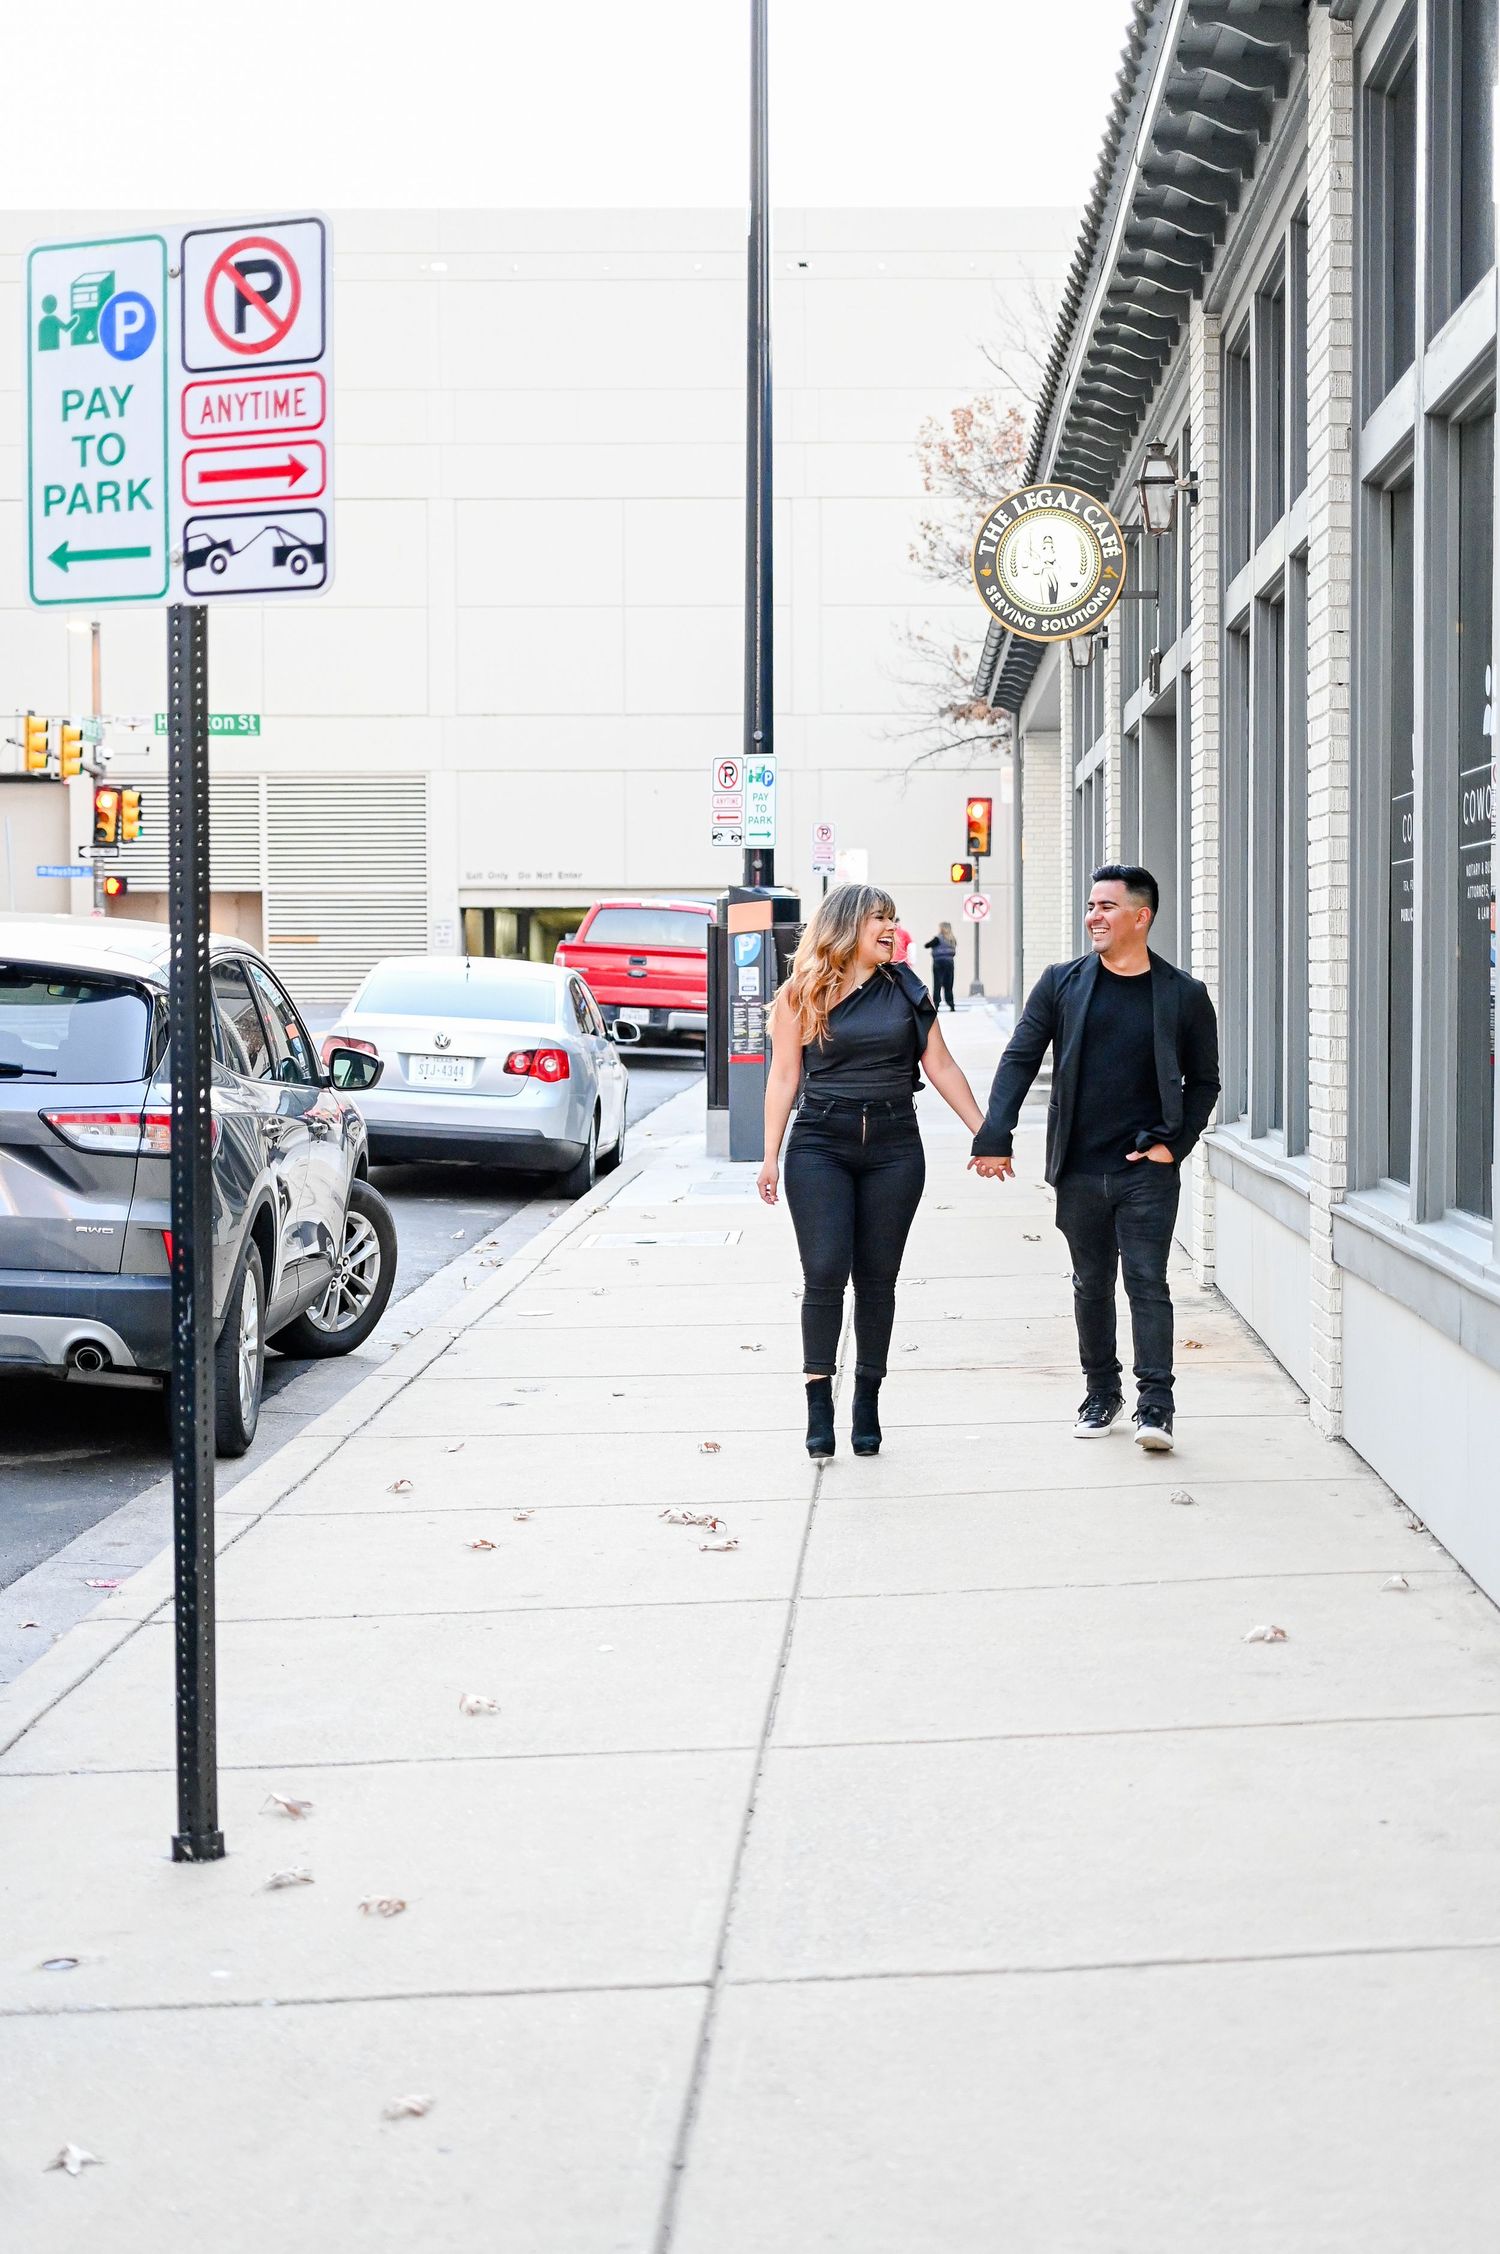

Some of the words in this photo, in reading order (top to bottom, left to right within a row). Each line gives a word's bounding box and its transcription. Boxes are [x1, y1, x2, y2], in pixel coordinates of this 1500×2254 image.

[61, 384, 135, 423] PAY
[200, 387, 307, 425] ANYTIME
[71, 432, 126, 468] TO
[43, 478, 154, 517] PARK
[978, 509, 1013, 556] THE
[1010, 489, 1082, 516] LEGAL
[985, 584, 1037, 630] SERVING
[1041, 585, 1112, 632] SOLUTIONS
[238, 714, 257, 730] St
[752, 792, 769, 801] PAY
[755, 804, 767, 813] TO
[748, 816, 773, 825] PARK
[1402, 812, 1414, 844] CO
